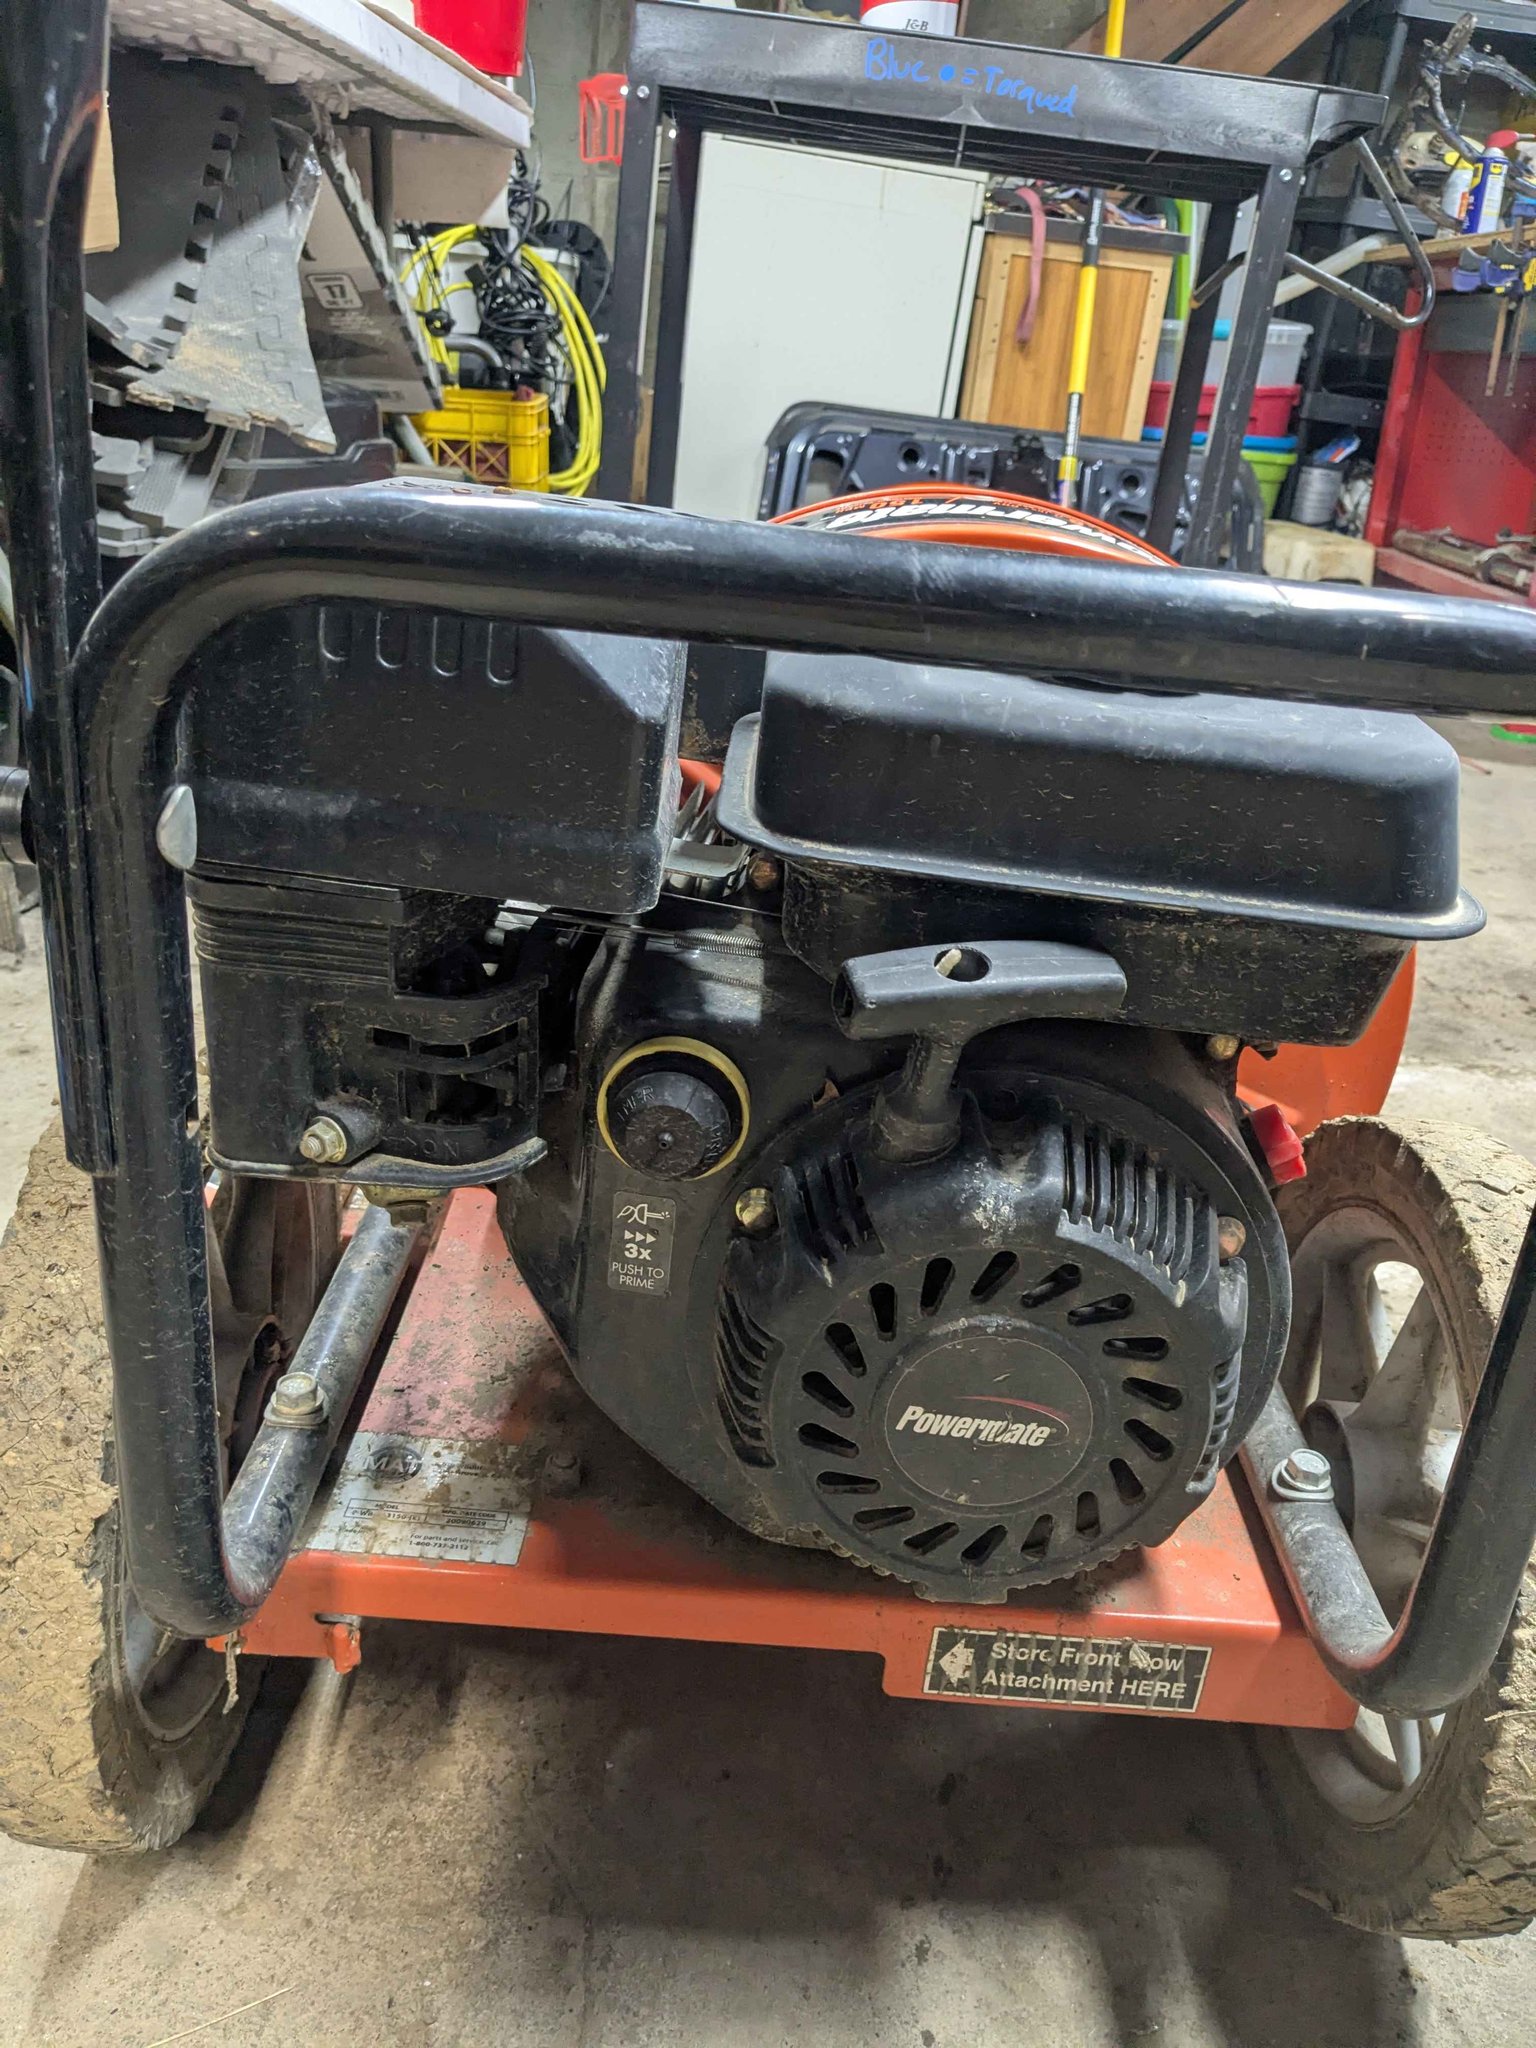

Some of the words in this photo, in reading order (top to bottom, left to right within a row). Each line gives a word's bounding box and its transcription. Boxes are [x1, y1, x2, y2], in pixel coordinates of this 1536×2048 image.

[864, 37, 930, 82] Blue
[984, 66, 1078, 117] Torqued
[322, 284, 346, 299] 17
[624, 1243, 652, 1261] 3x
[612, 1262, 643, 1277] PUSH
[648, 1267, 664, 1279] TO
[619, 1275, 655, 1289] PRIME
[895, 1405, 1051, 1447] Powermate
[1060, 1647, 1123, 1668] Front
[981, 1669, 1115, 1694] Attachment
[1120, 1679, 1187, 1699] HERE
